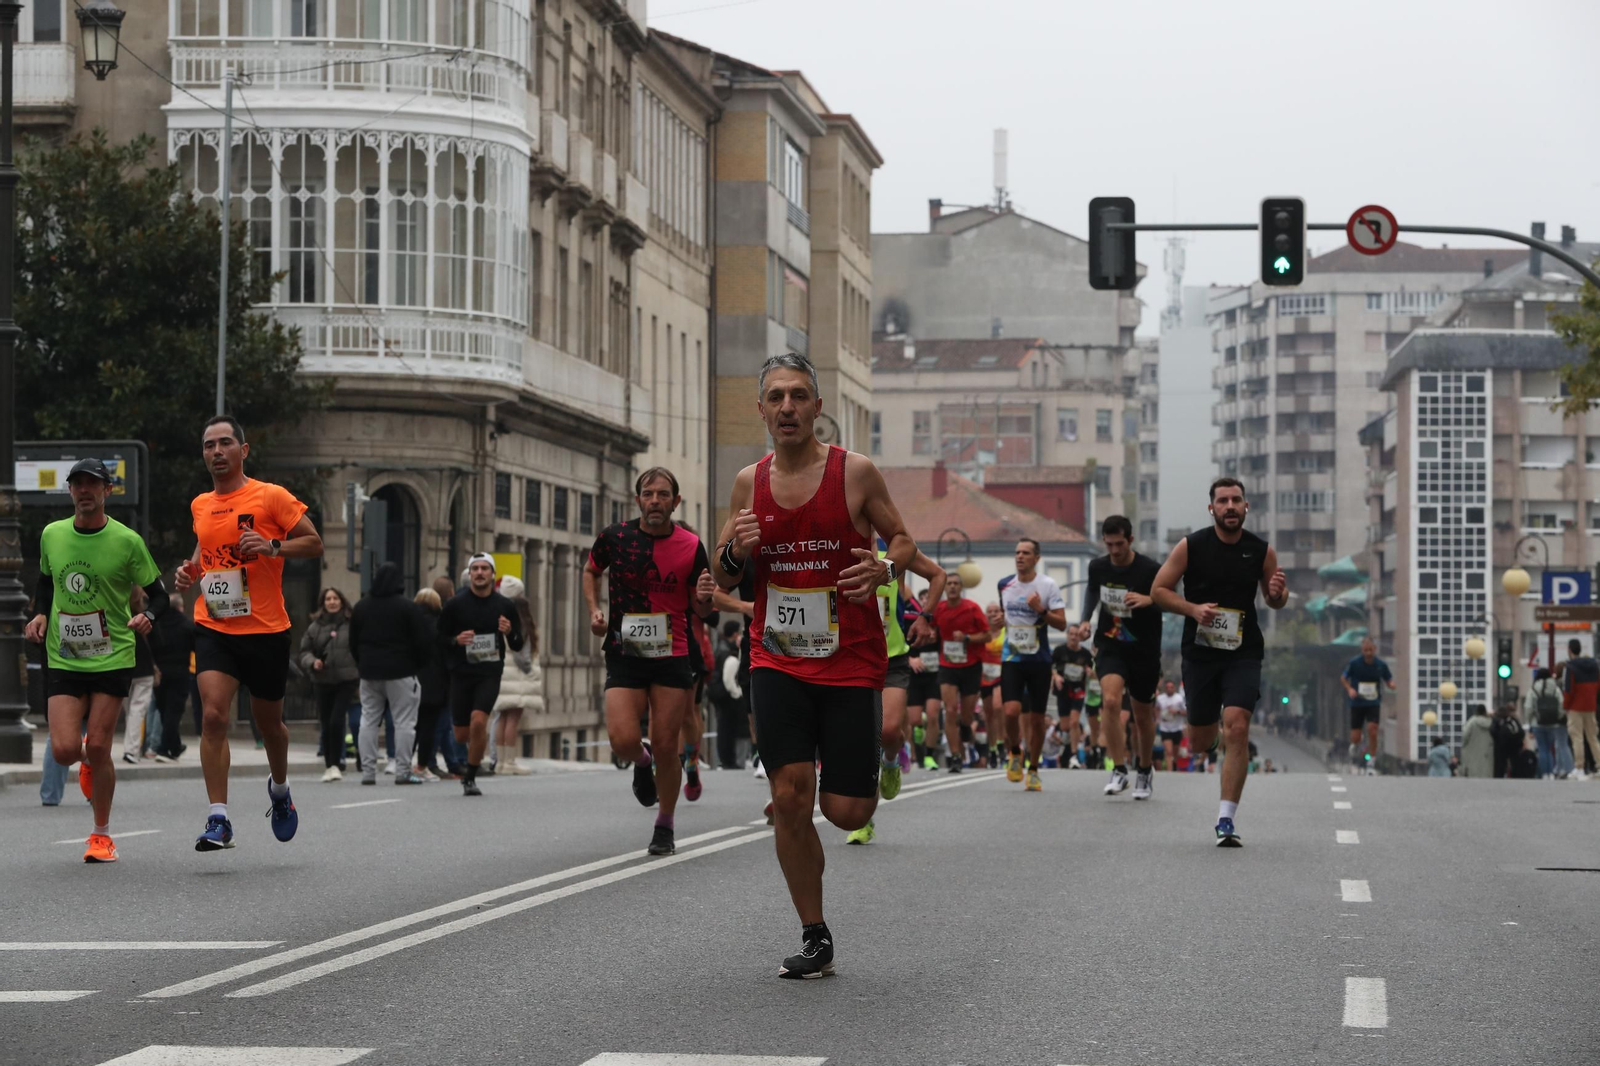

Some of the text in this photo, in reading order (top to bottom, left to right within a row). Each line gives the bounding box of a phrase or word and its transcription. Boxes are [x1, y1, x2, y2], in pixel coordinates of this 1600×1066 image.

[761, 540, 839, 555] ALEX TEAM
[207, 581, 230, 596] 452
[1552, 576, 1579, 605] P
[782, 595, 801, 603] JONATAN
[778, 606, 805, 625] 571
[64, 623, 93, 638] 9655
[629, 624, 658, 638] 2731
